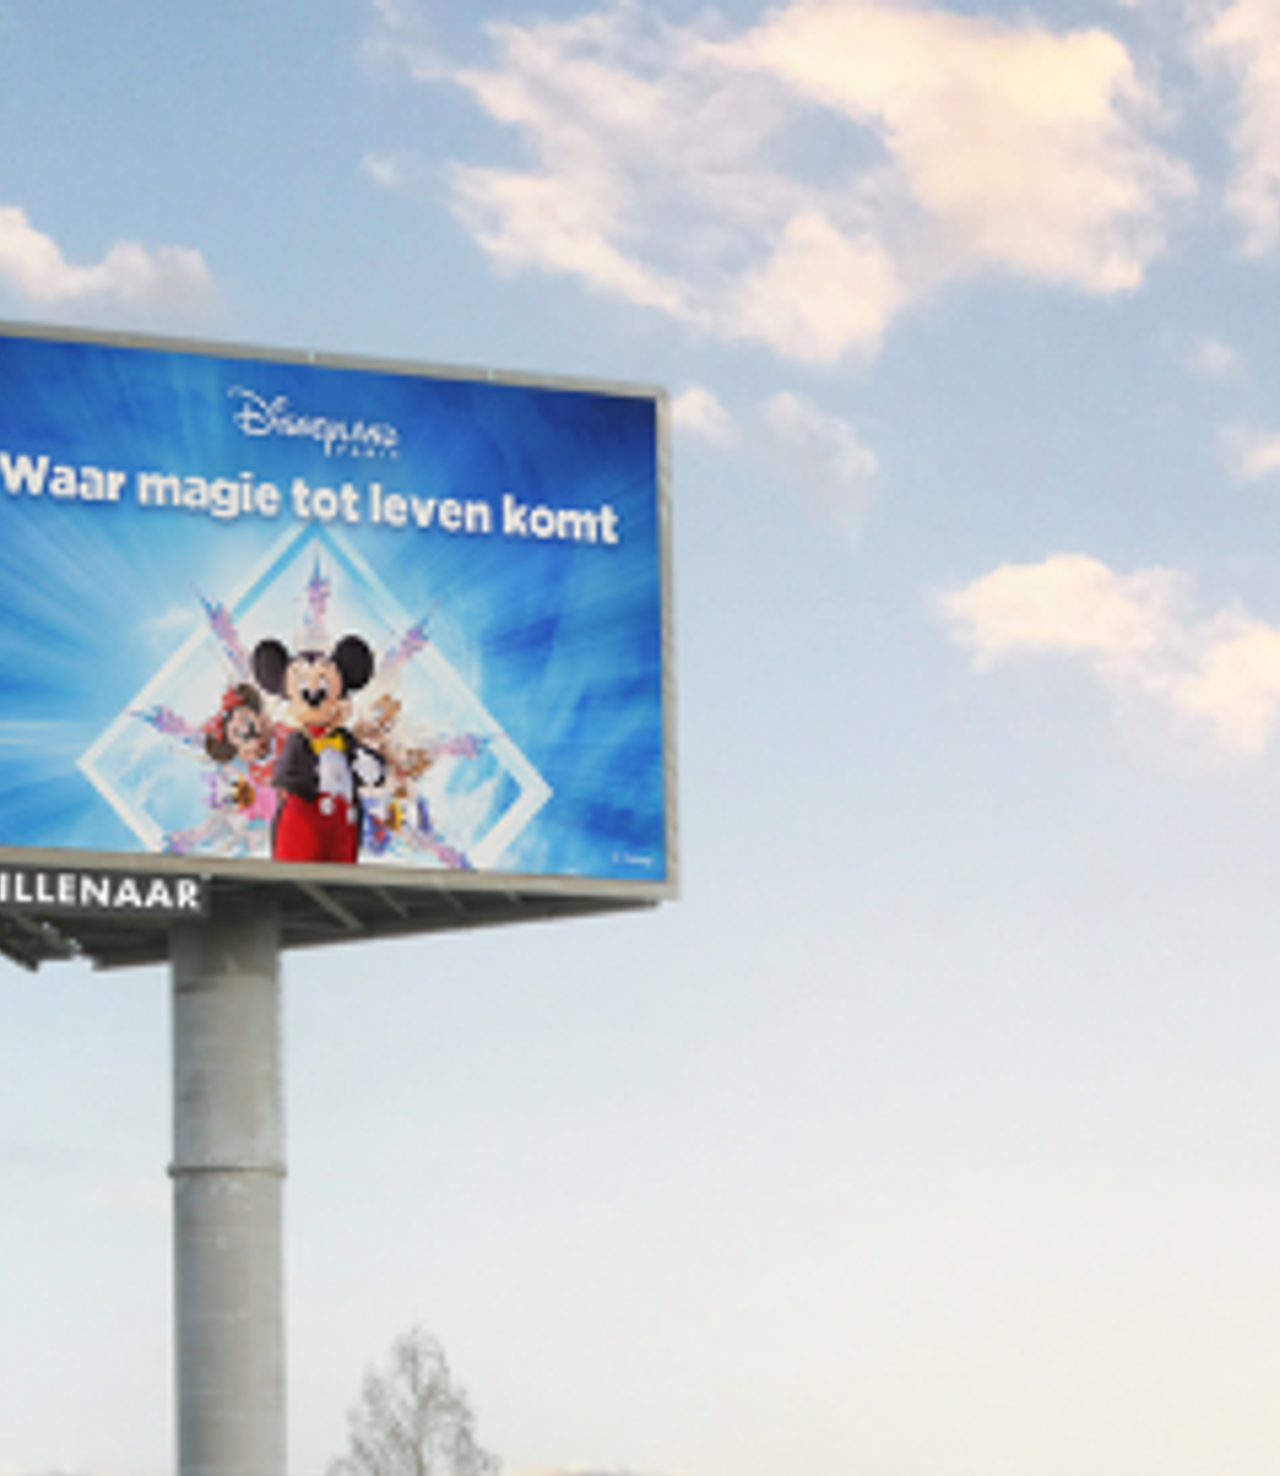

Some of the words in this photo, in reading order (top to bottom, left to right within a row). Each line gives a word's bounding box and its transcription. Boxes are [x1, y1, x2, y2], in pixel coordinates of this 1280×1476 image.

[138, 471, 280, 518] magie
[292, 479, 359, 522] tot
[371, 483, 490, 533] leven
[503, 494, 618, 544] komt
